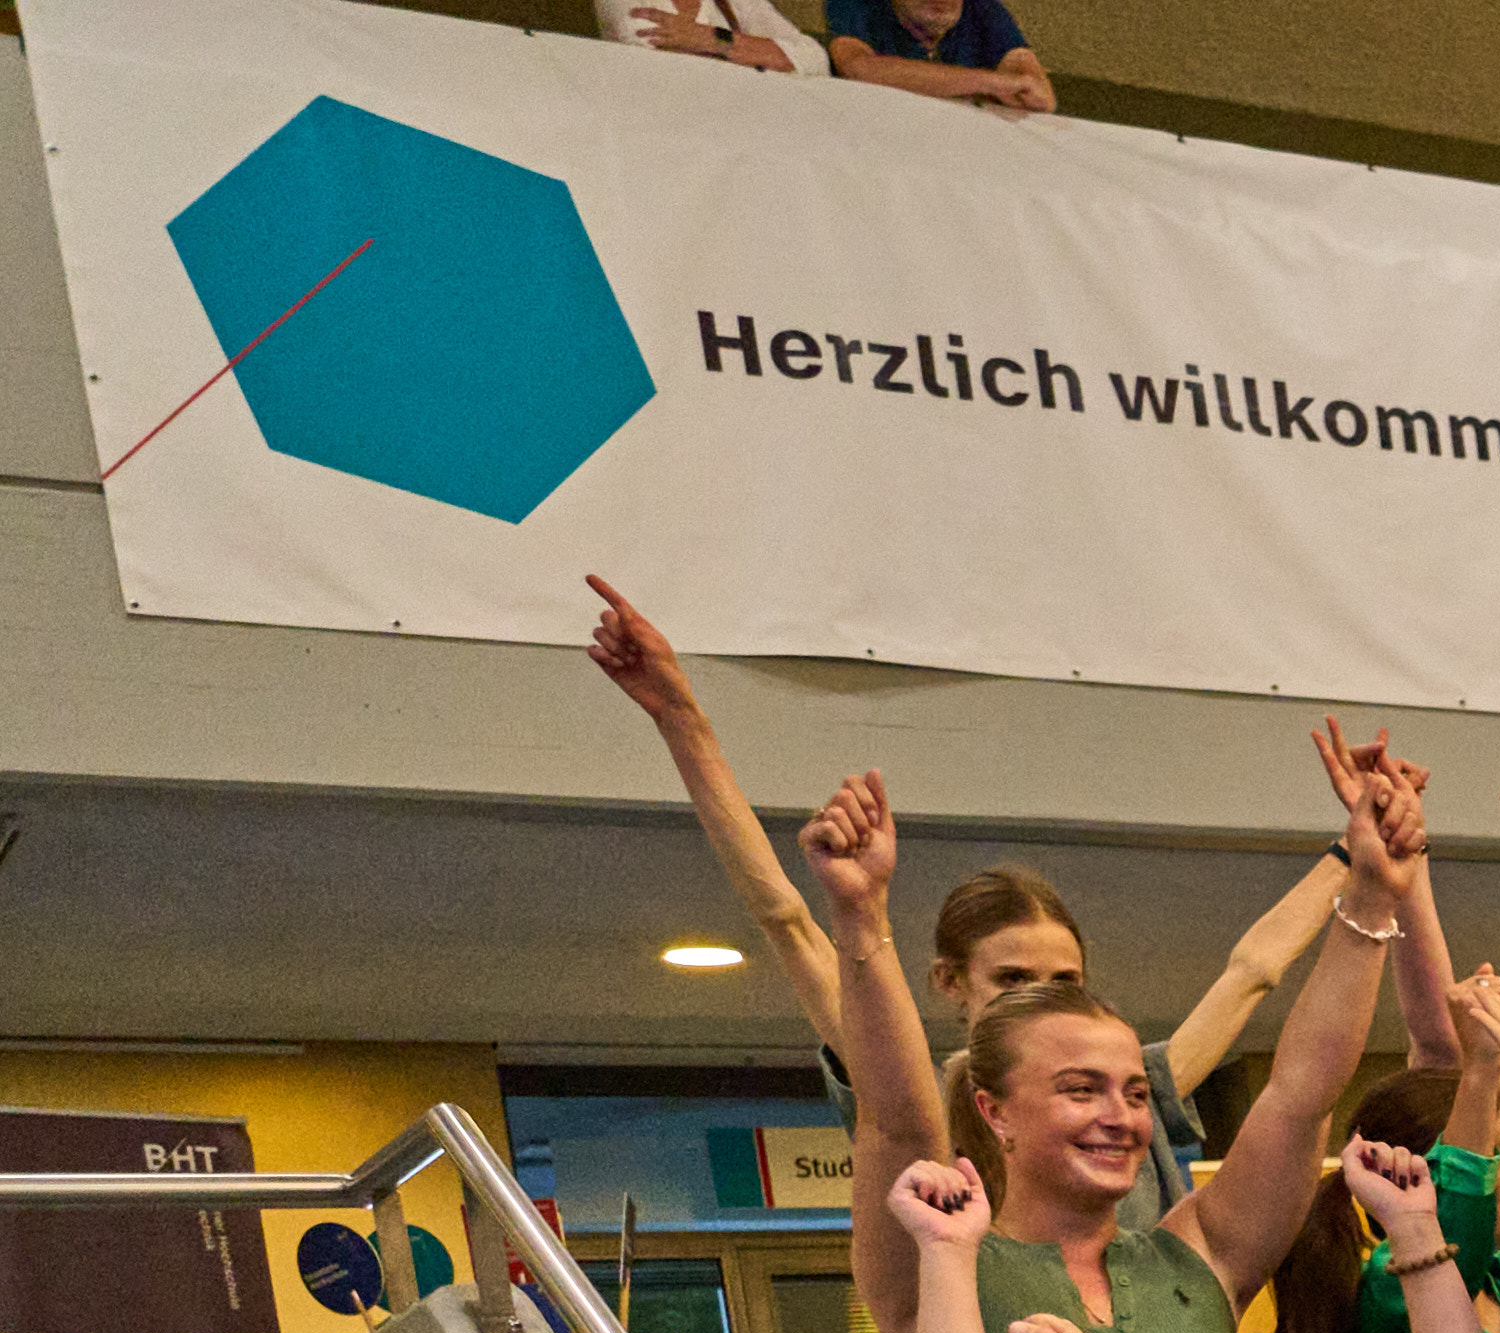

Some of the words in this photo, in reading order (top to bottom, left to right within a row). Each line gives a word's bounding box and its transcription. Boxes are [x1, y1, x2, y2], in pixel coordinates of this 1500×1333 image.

[696, 309, 1087, 415] Herzlich
[142, 1140, 219, 1174] BHT
[794, 1156, 854, 1180] Stud
